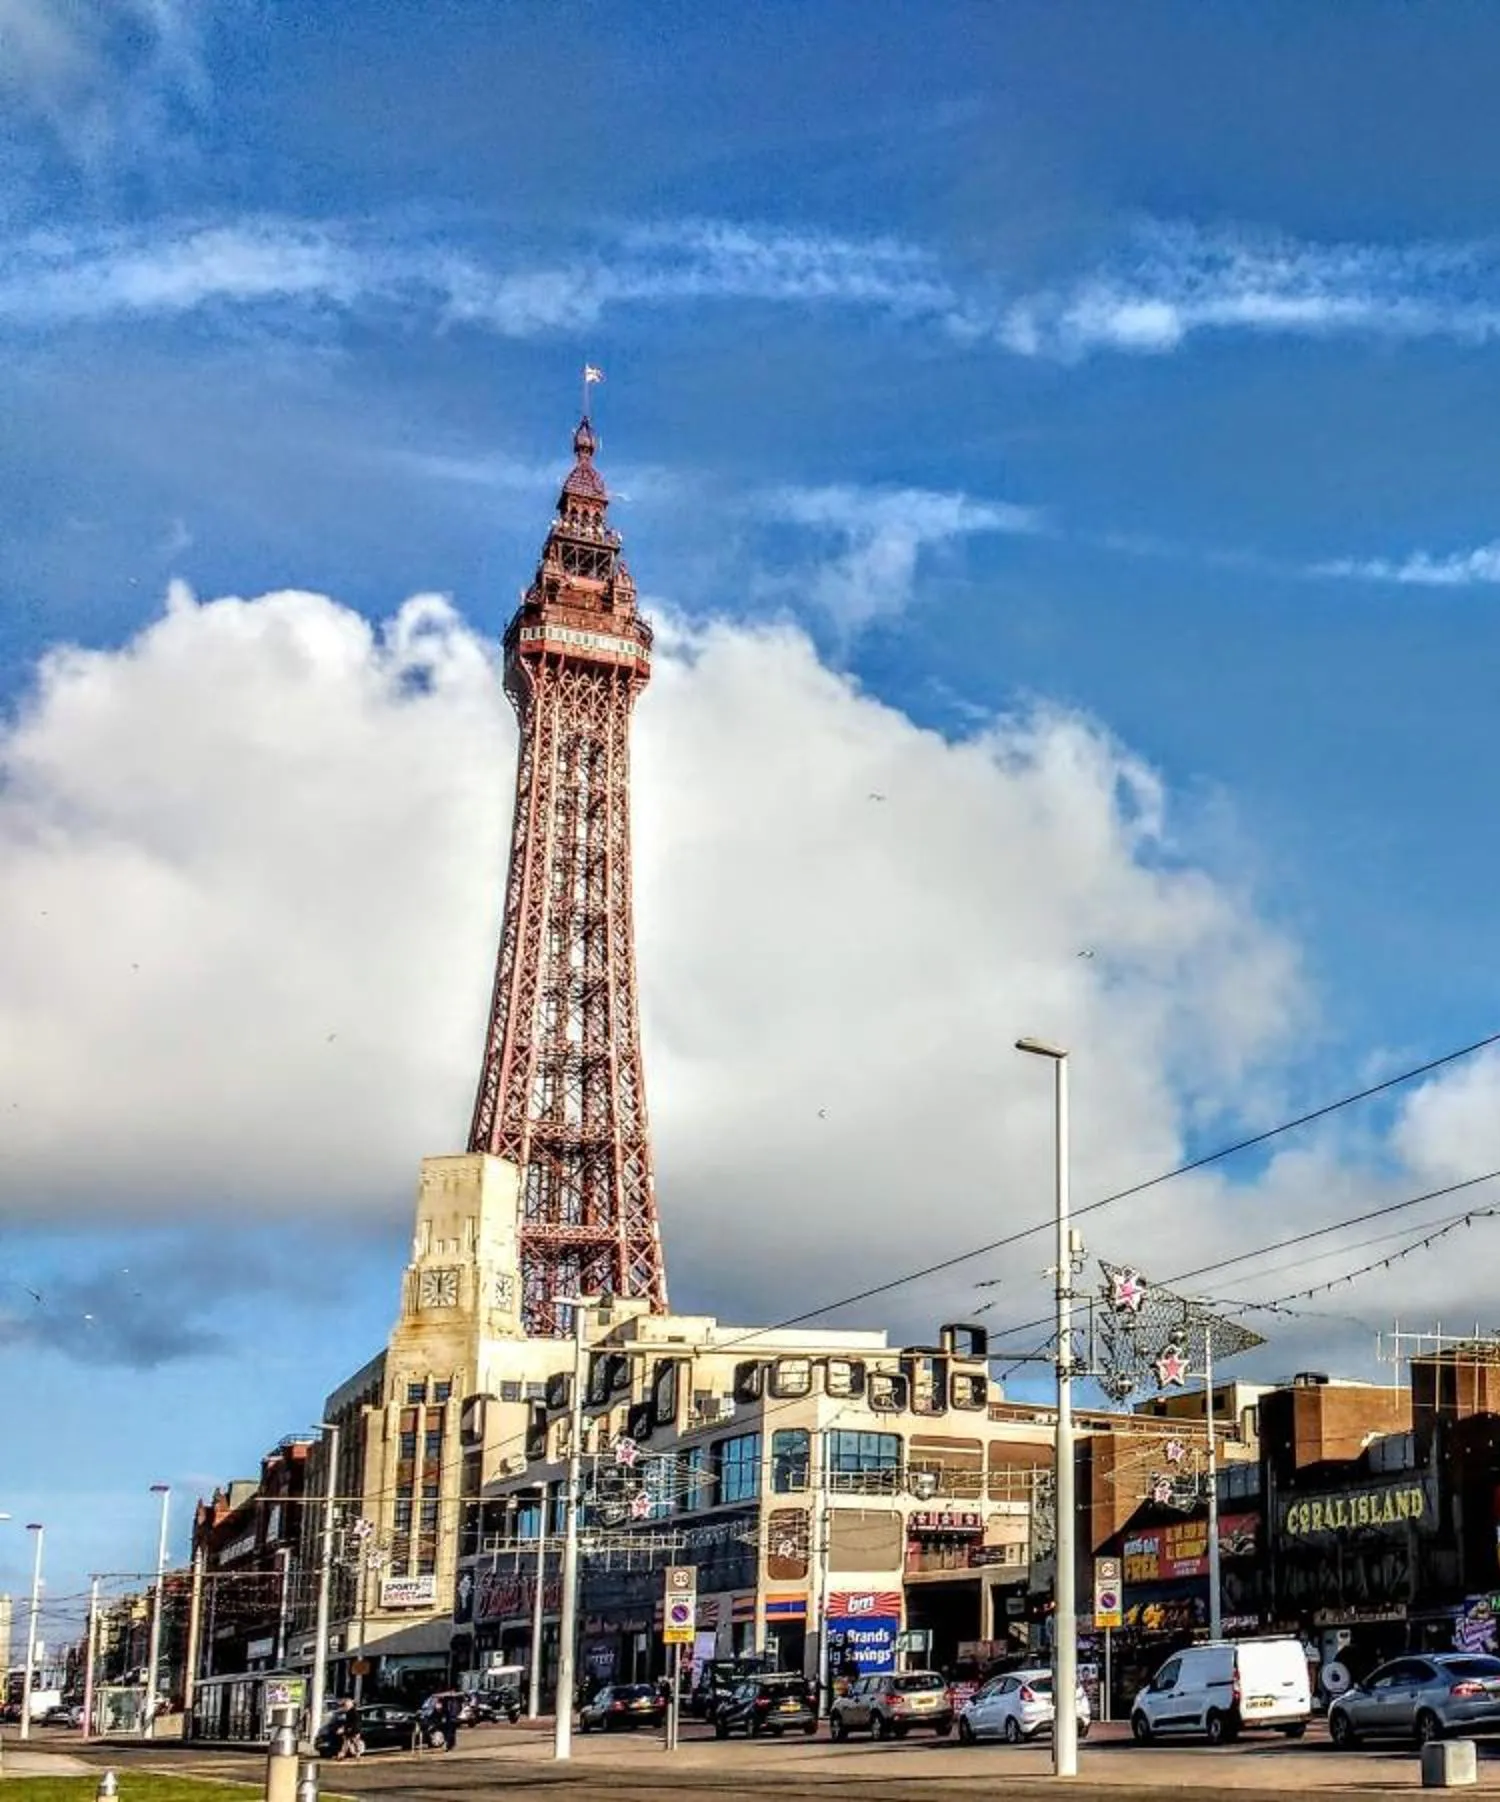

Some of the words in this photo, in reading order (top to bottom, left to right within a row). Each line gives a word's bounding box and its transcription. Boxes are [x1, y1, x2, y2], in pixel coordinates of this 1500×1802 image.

[1287, 1498, 1348, 1535] CORAL
[1350, 1487, 1424, 1527] ISLAND
[847, 1627, 890, 1644] Brands
[844, 1646, 891, 1665] Savings
